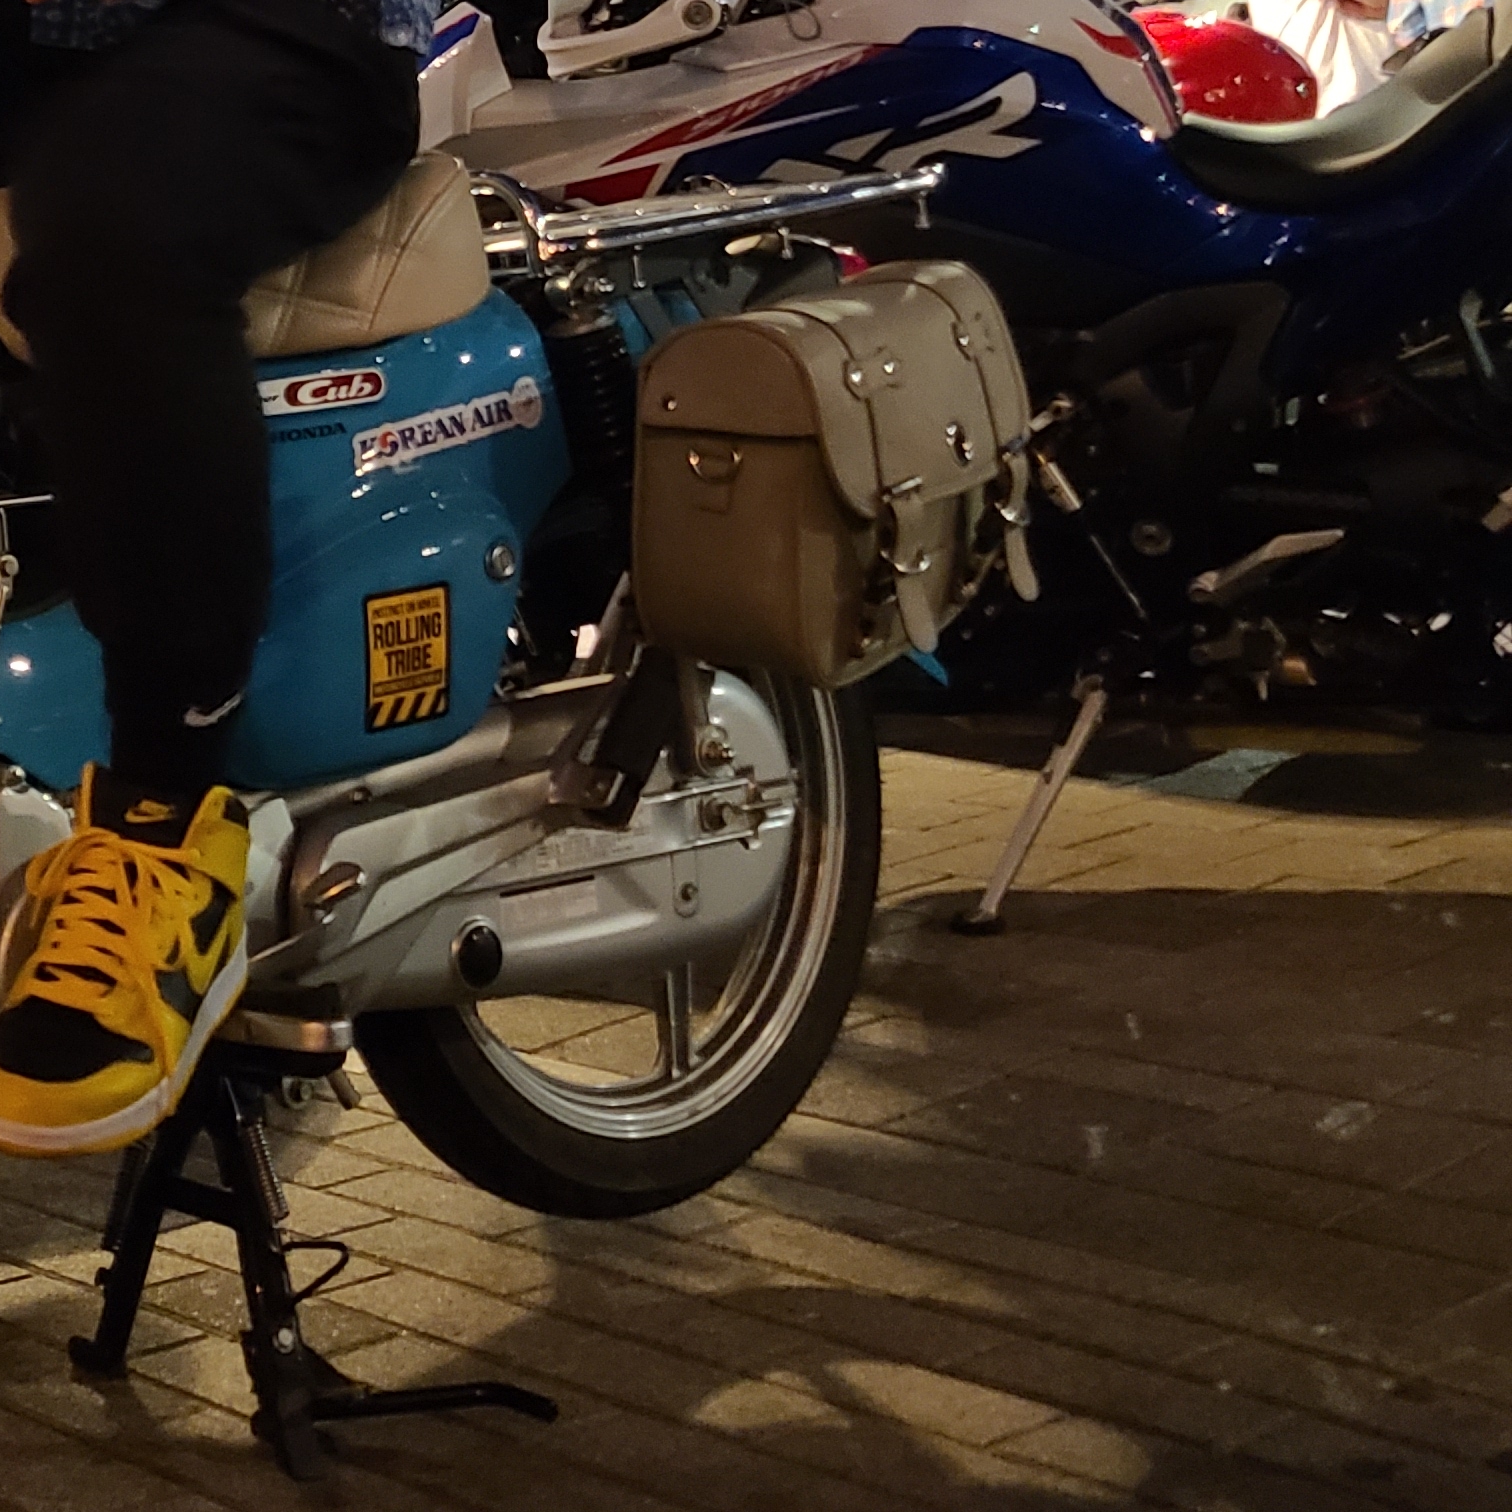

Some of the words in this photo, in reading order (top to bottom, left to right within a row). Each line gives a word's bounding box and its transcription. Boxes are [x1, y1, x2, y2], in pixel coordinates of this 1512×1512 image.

[296, 374, 373, 404] Cub
[271, 422, 347, 443] HONDA
[358, 410, 467, 462] KOREAN
[471, 398, 513, 432] AIR
[373, 612, 442, 650] ROLLING
[384, 643, 433, 676] TRIBE
